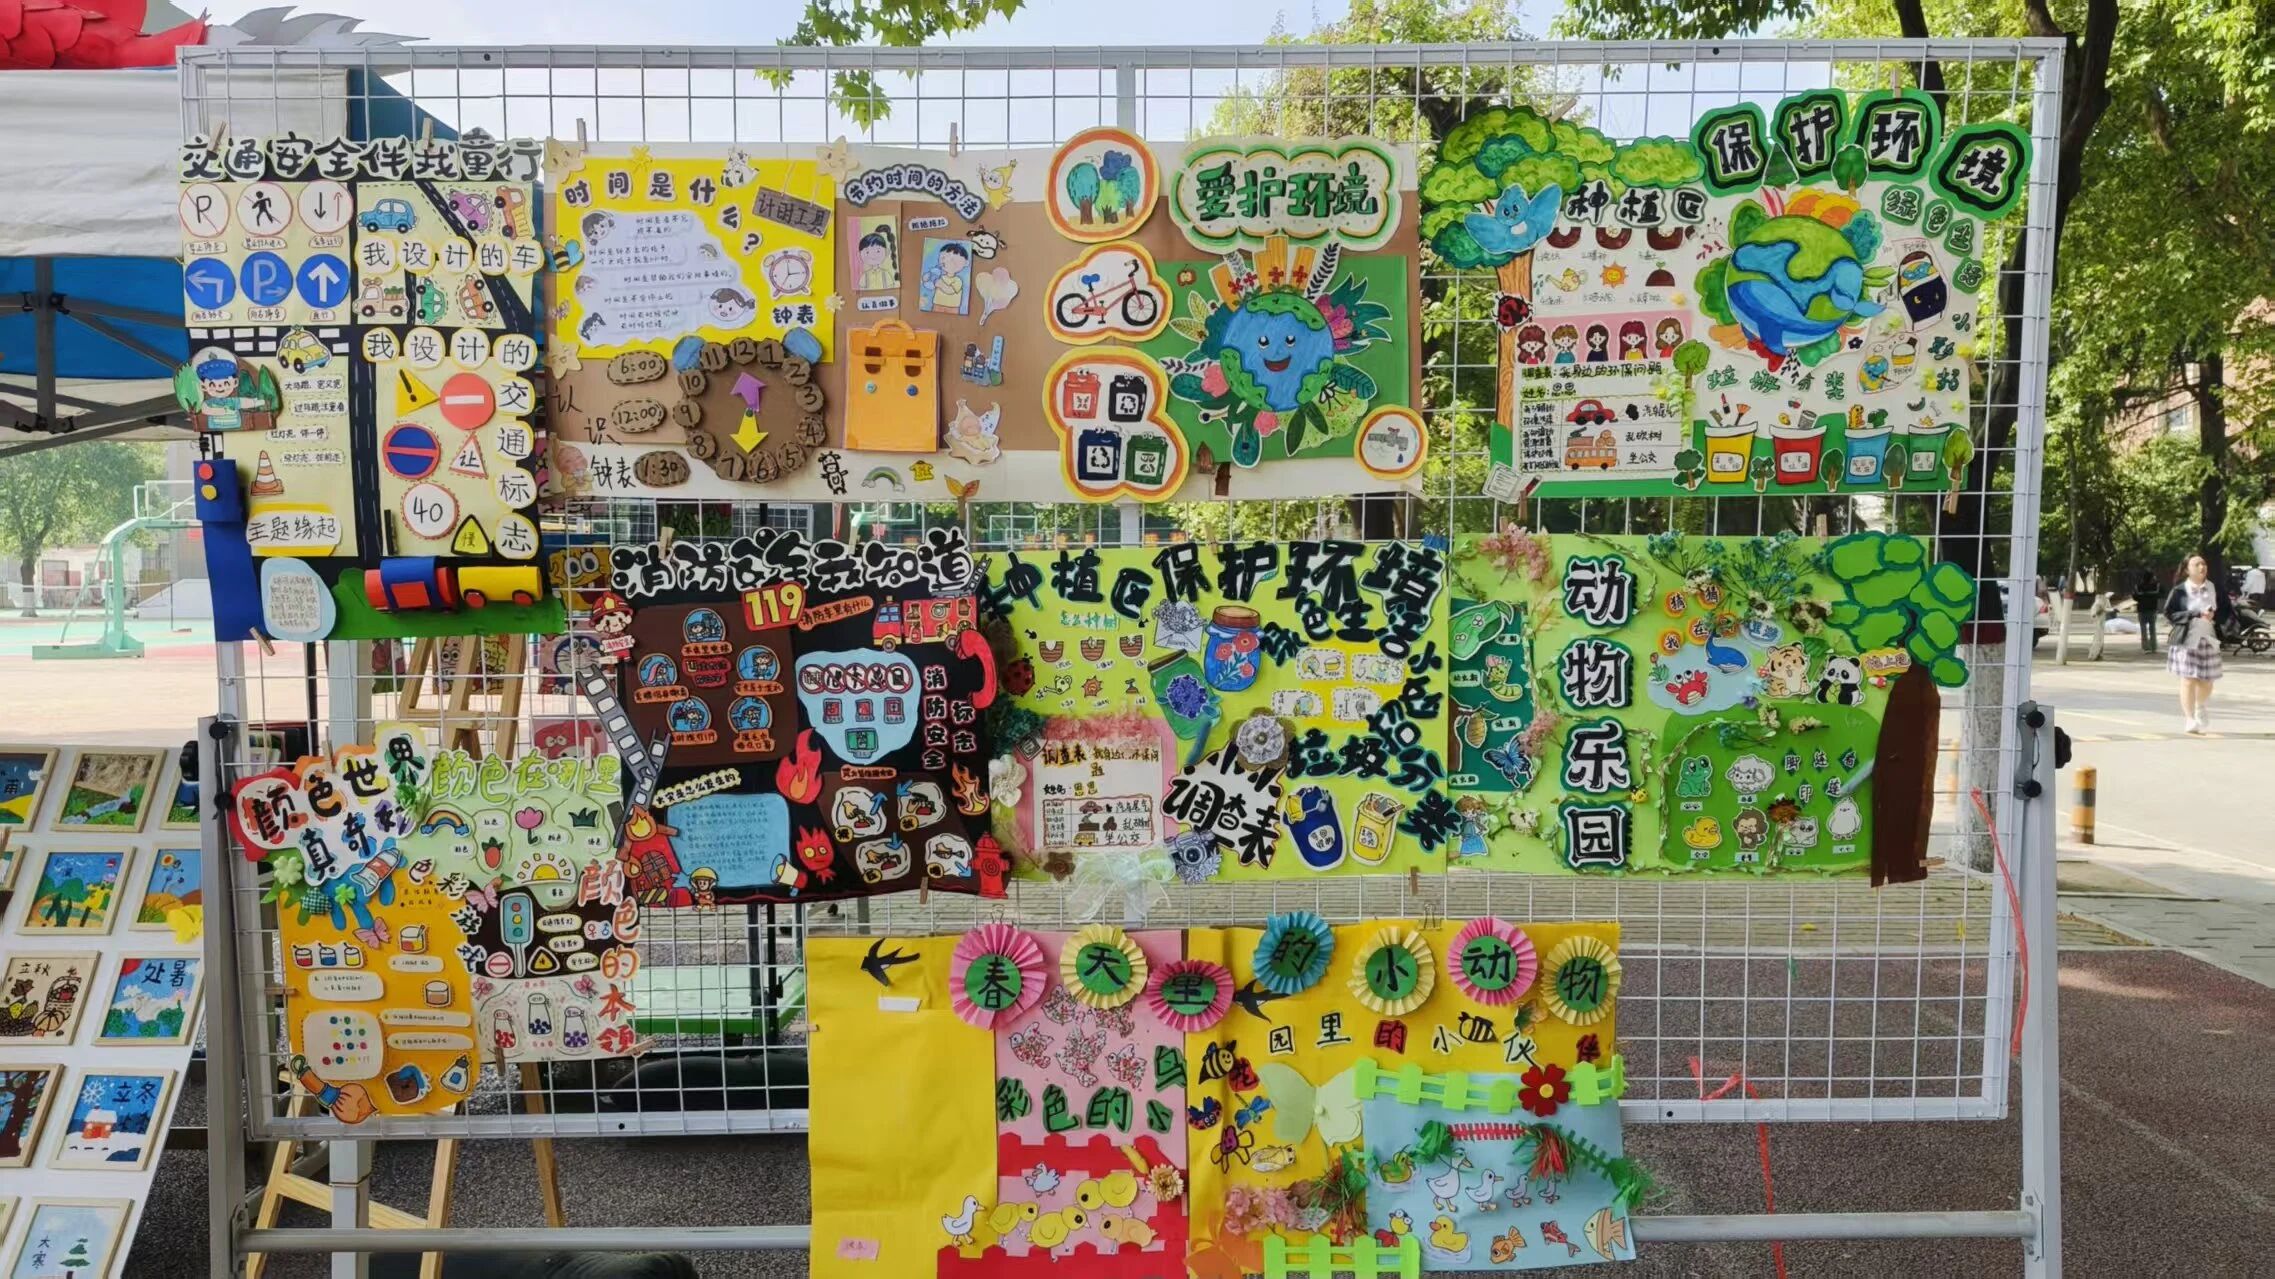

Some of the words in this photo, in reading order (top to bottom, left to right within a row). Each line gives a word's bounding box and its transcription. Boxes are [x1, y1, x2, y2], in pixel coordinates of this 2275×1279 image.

[183, 127, 542, 181] 交通安全伴我童行
[1713, 106, 2012, 195] 保护环境
[849, 170, 979, 217] 节约时间的方法
[1568, 182, 1704, 222] 种植区
[364, 243, 537, 269] 我设计的车
[772, 305, 815, 324] 钟表
[367, 332, 530, 364] 我设计的
[704, 348, 724, 366] 11
[729, 341, 749, 358] 12
[764, 347, 783, 367] 1
[620, 358, 658, 375] 6:00
[788, 362, 807, 380] 2
[685, 375, 702, 390] 10
[1707, 365, 1846, 401] 垃圾分类
[802, 387, 818, 405] 3
[617, 406, 658, 425] 12:00
[680, 404, 693, 424] 9
[693, 434, 709, 456] 8
[804, 422, 820, 444] 4
[459, 450, 480, 468] 让
[497, 380, 533, 552] 交通标志
[643, 458, 679, 478] 1:30
[721, 457, 737, 478] 7
[757, 457, 773, 481] 6
[785, 446, 798, 469] 5
[1627, 451, 1657, 465] 坐公交
[413, 496, 444, 524] 40
[249, 516, 336, 542] 主题缘起
[610, 527, 973, 597] 消防安全我知道
[1153, 538, 1446, 618] 保护环境
[745, 588, 804, 625] 119
[1669, 586, 1721, 611] 猜猜
[800, 601, 873, 629] 消防车里有什么
[925, 667, 948, 769] 消防安全
[1565, 556, 1632, 865] 动物乐园
[952, 700, 976, 752] 标志
[1043, 743, 1087, 766] 调查表
[247, 736, 425, 842] 颜色世界
[432, 748, 622, 805] 颜色在哪里
[1163, 779, 1281, 868] 调查表
[1104, 831, 1140, 846] 坐公交
[578, 859, 641, 1053] 颜色的本领
[18, 962, 51, 977] 立秋
[141, 959, 187, 988] 处暑
[976, 929, 1602, 1011] 春天里的小动物
[112, 1081, 157, 1105] 立冬
[998, 1045, 1188, 1134] 彩色的小鸟
[31, 1235, 51, 1270] 大寒
